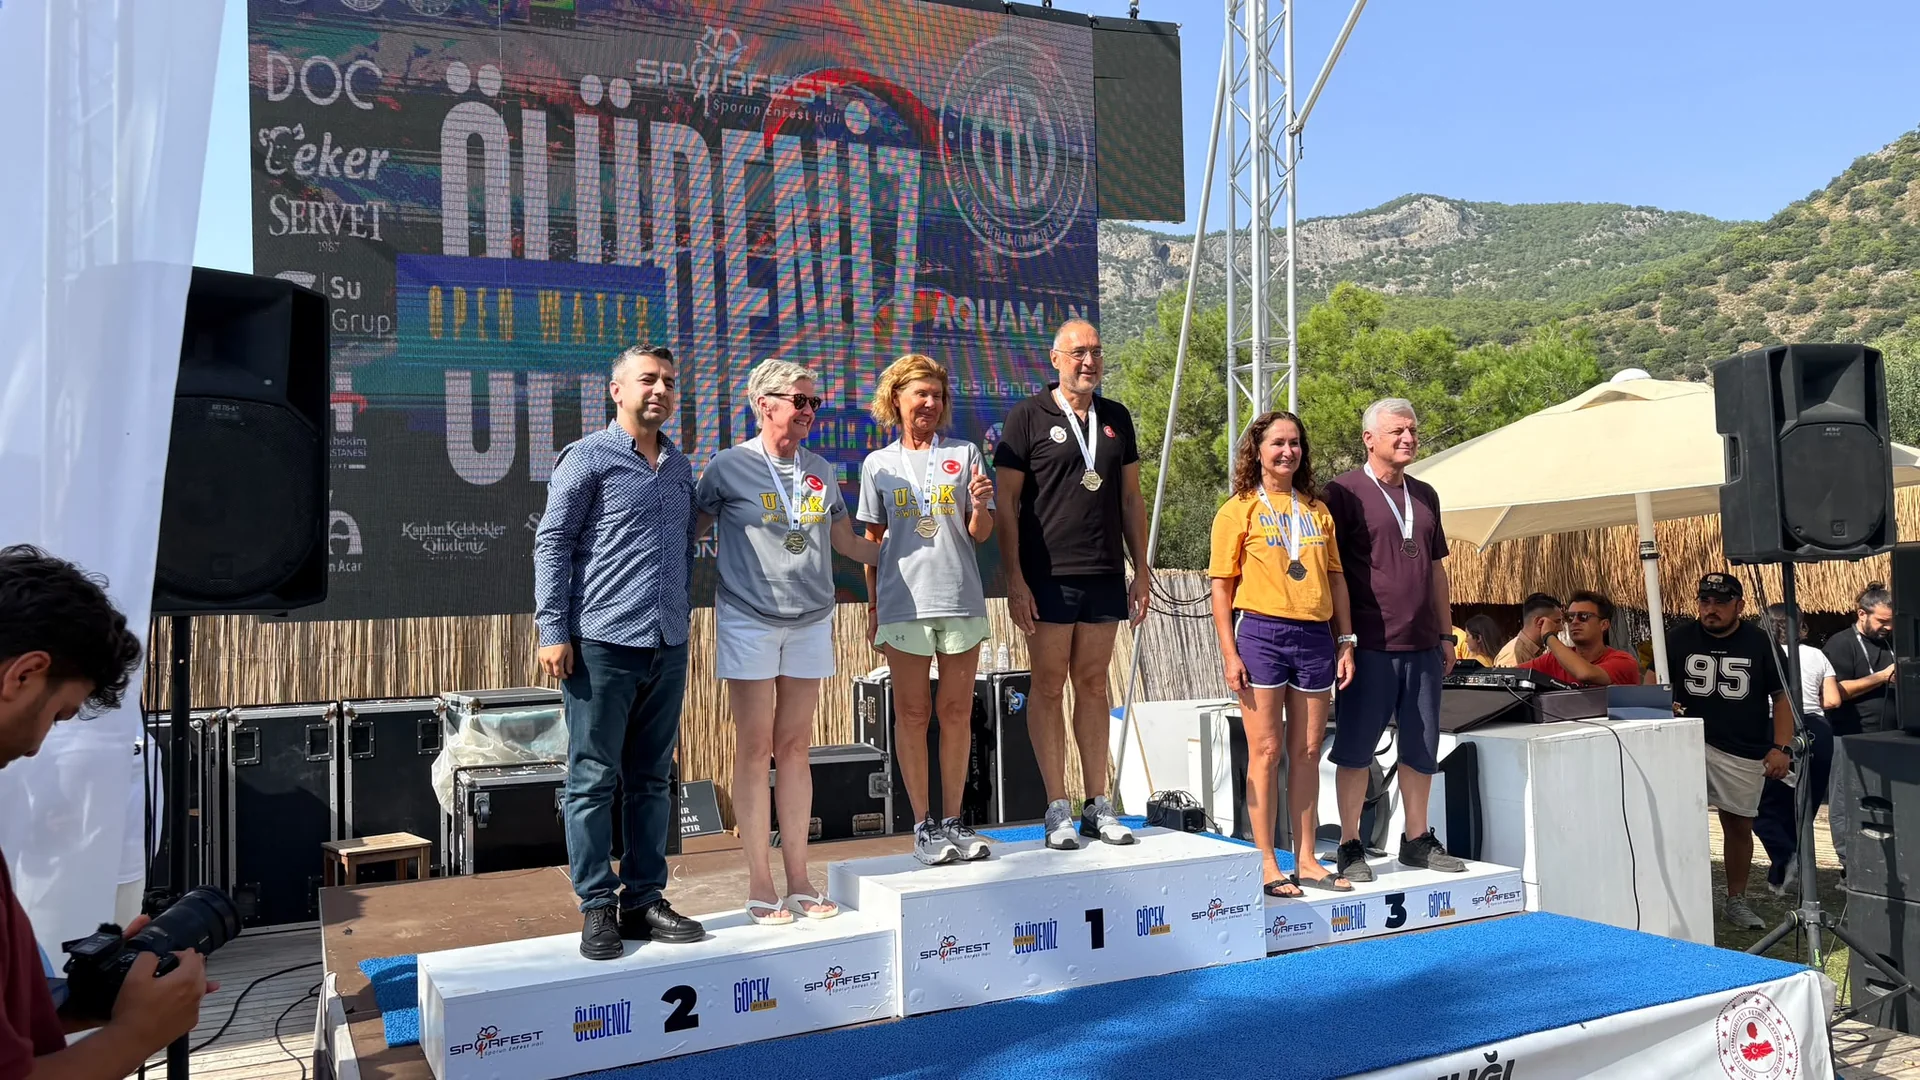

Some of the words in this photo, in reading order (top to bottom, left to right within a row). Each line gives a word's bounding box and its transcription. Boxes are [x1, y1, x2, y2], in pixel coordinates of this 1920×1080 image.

[267, 51, 382, 110] DOC
[636, 57, 840, 105] SPORFEST
[713, 98, 760, 115] Sporun
[815, 111, 840, 124] Hali
[268, 194, 386, 242] SERVET
[330, 276, 361, 300] Su
[331, 308, 391, 339] Grup
[428, 285, 513, 341] OPEN
[537, 290, 649, 346] WATER
[329, 436, 366, 446] hekim
[401, 522, 446, 542] Kaplan
[422, 536, 487, 555] Ölüdeniz
[337, 559, 362, 572] Acar
[1684, 653, 1752, 700] 95
[1191, 903, 1251, 921] SPORFEST
[1385, 892, 1408, 929] 3
[1428, 890, 1452, 919] GÖÇEK
[1472, 888, 1521, 905] SPORFEST
[1085, 908, 1105, 949] 1
[1136, 905, 1166, 937] GÖÇEK
[1331, 901, 1367, 933] ÖLÜDENİZ
[920, 941, 990, 960] SPORFEST
[1014, 918, 1058, 955] ÖLÜDENİZ
[734, 977, 770, 1014] GÖÇEK
[804, 970, 880, 993] SPORFEST
[574, 999, 632, 1043] ÖLÜDENİZ
[660, 984, 699, 1034] 2
[450, 1028, 543, 1057] SPORFEST
